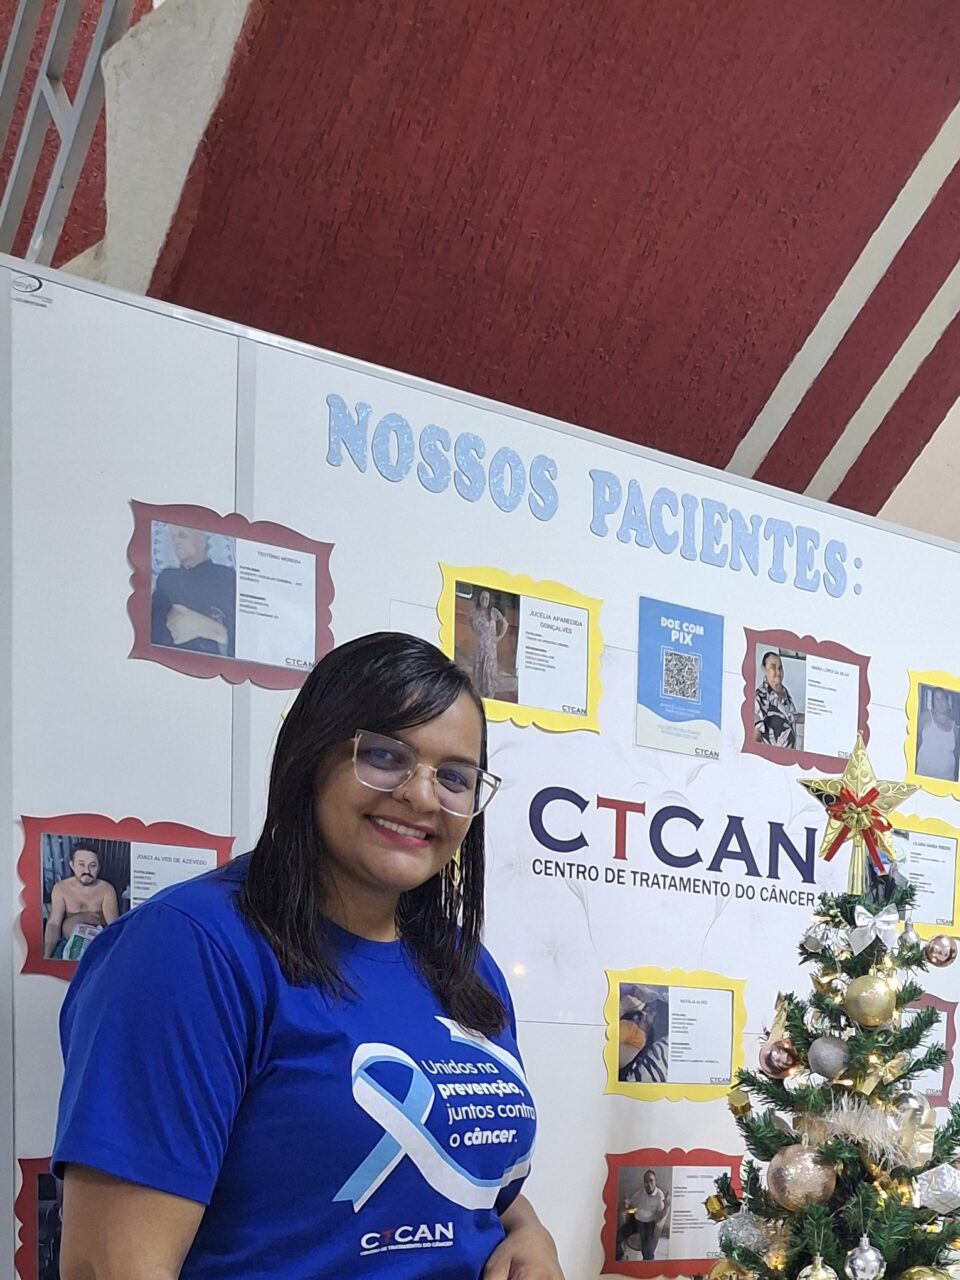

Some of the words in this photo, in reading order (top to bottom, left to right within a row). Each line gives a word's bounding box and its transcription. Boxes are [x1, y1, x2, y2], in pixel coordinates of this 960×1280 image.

[326, 394, 558, 522] NOSSOS
[589, 469, 863, 598] PACIENTES:
[553, 615, 583, 627] APARECIDA
[660, 616, 681, 631] DOE
[682, 621, 705, 636] COM
[671, 629, 693, 646] PIX
[562, 704, 587, 714] CTCAN
[694, 747, 720, 757] CTCAN
[528, 786, 819, 884] CTCAN
[532, 858, 599, 882] CENTRO
[604, 867, 626, 885] DE
[630, 870, 730, 897] TRATAMENTO
[735, 883, 756, 900] DO
[760, 884, 816, 907] CÂNCER
[421, 1059, 478, 1074] Unidos
[477, 1062, 499, 1074] na
[437, 1080, 525, 1099] prevenção,
[446, 1103, 495, 1125] juntos
[498, 1103, 536, 1120] contra
[449, 1133, 461, 1148] o
[464, 1127, 518, 1146] câncer.
[360, 1222, 454, 1249] CTCAN
